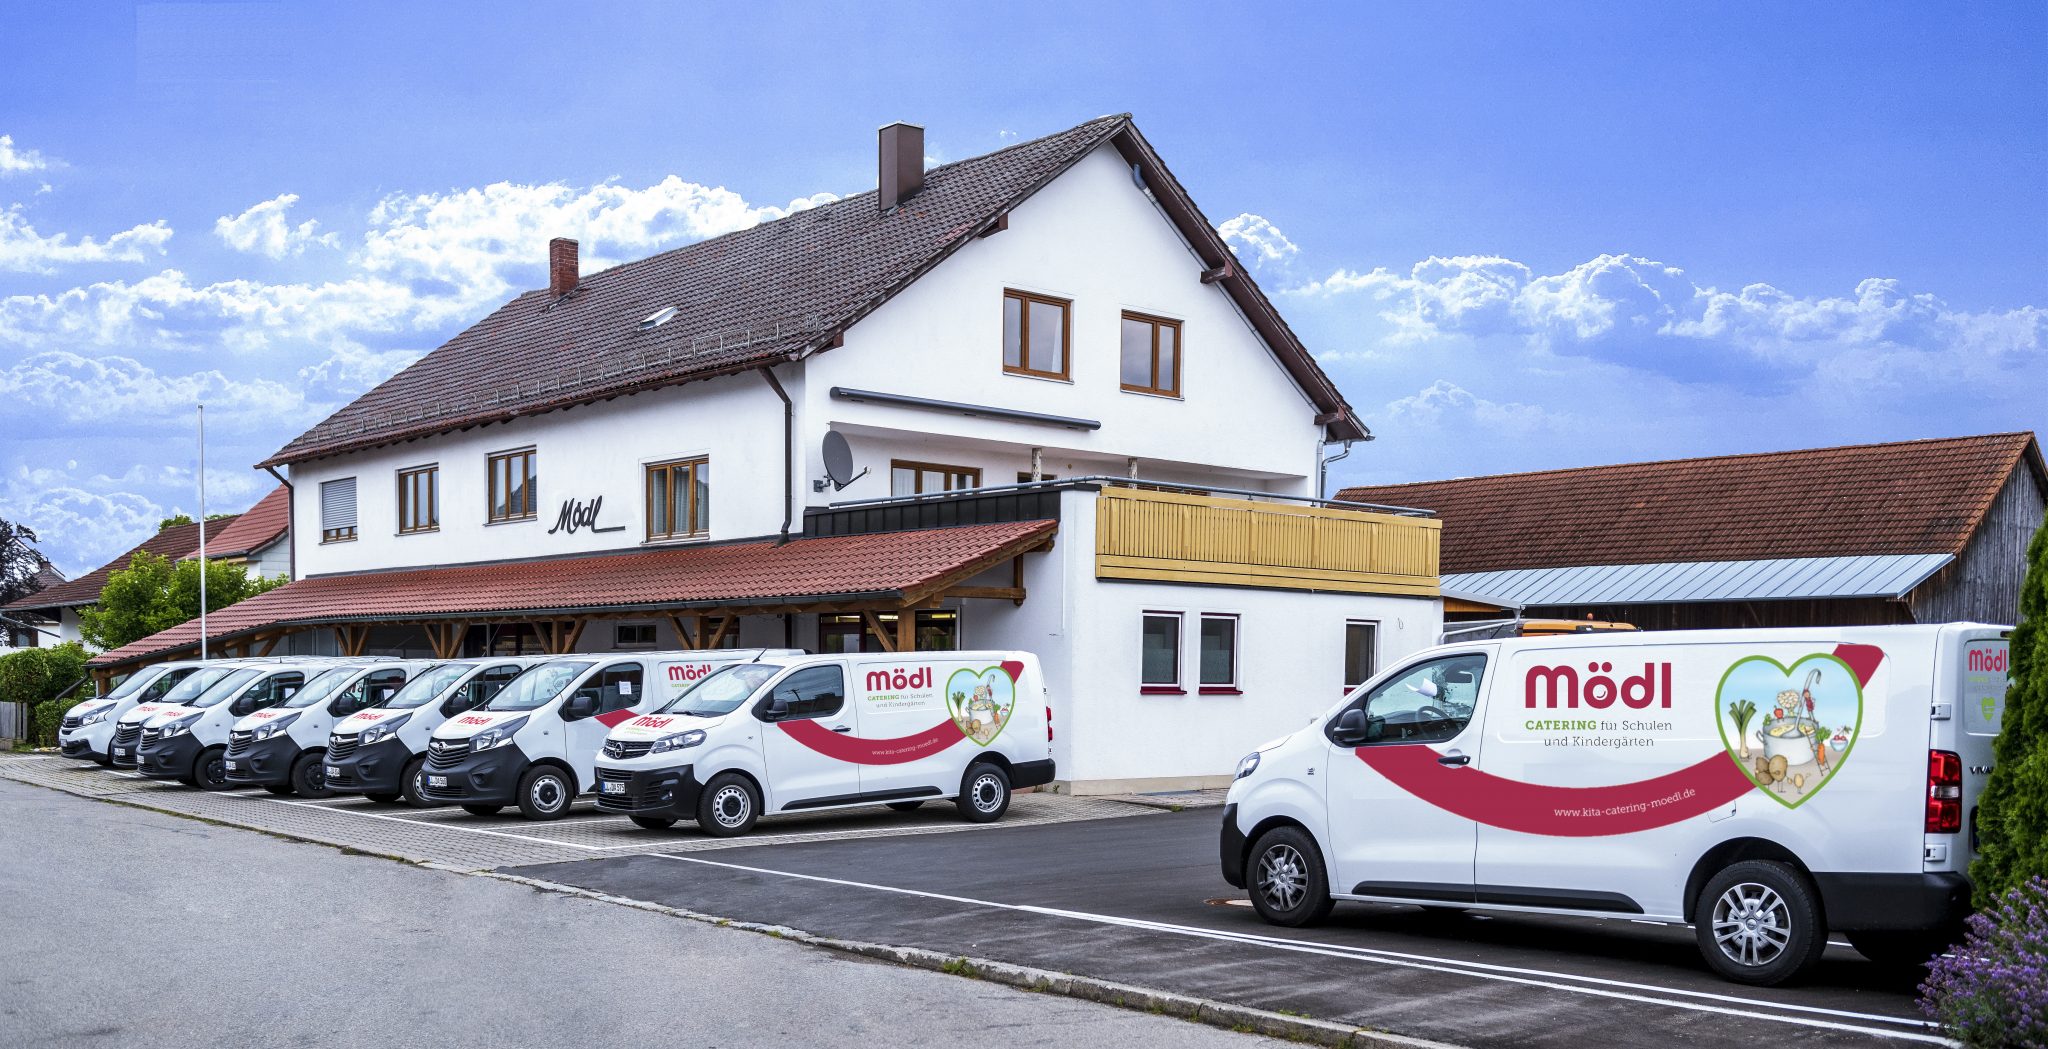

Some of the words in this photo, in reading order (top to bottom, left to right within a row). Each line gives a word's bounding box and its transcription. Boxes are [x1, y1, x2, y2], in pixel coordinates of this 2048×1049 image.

[1968, 648, 2007, 672] mödl
[866, 666, 932, 691] mödl
[1525, 661, 1672, 709] mödl
[456, 715, 494, 726] mödl
[632, 716, 674, 729] mödl
[1525, 720, 1597, 731] CATERING
[1601, 720, 1617, 731] für
[1622, 720, 1673, 731] Schulen
[1544, 736, 1568, 747] und
[1573, 736, 1654, 749] Kindergärten
[1554, 788, 1696, 818] www.kita-catering-moedl.de
